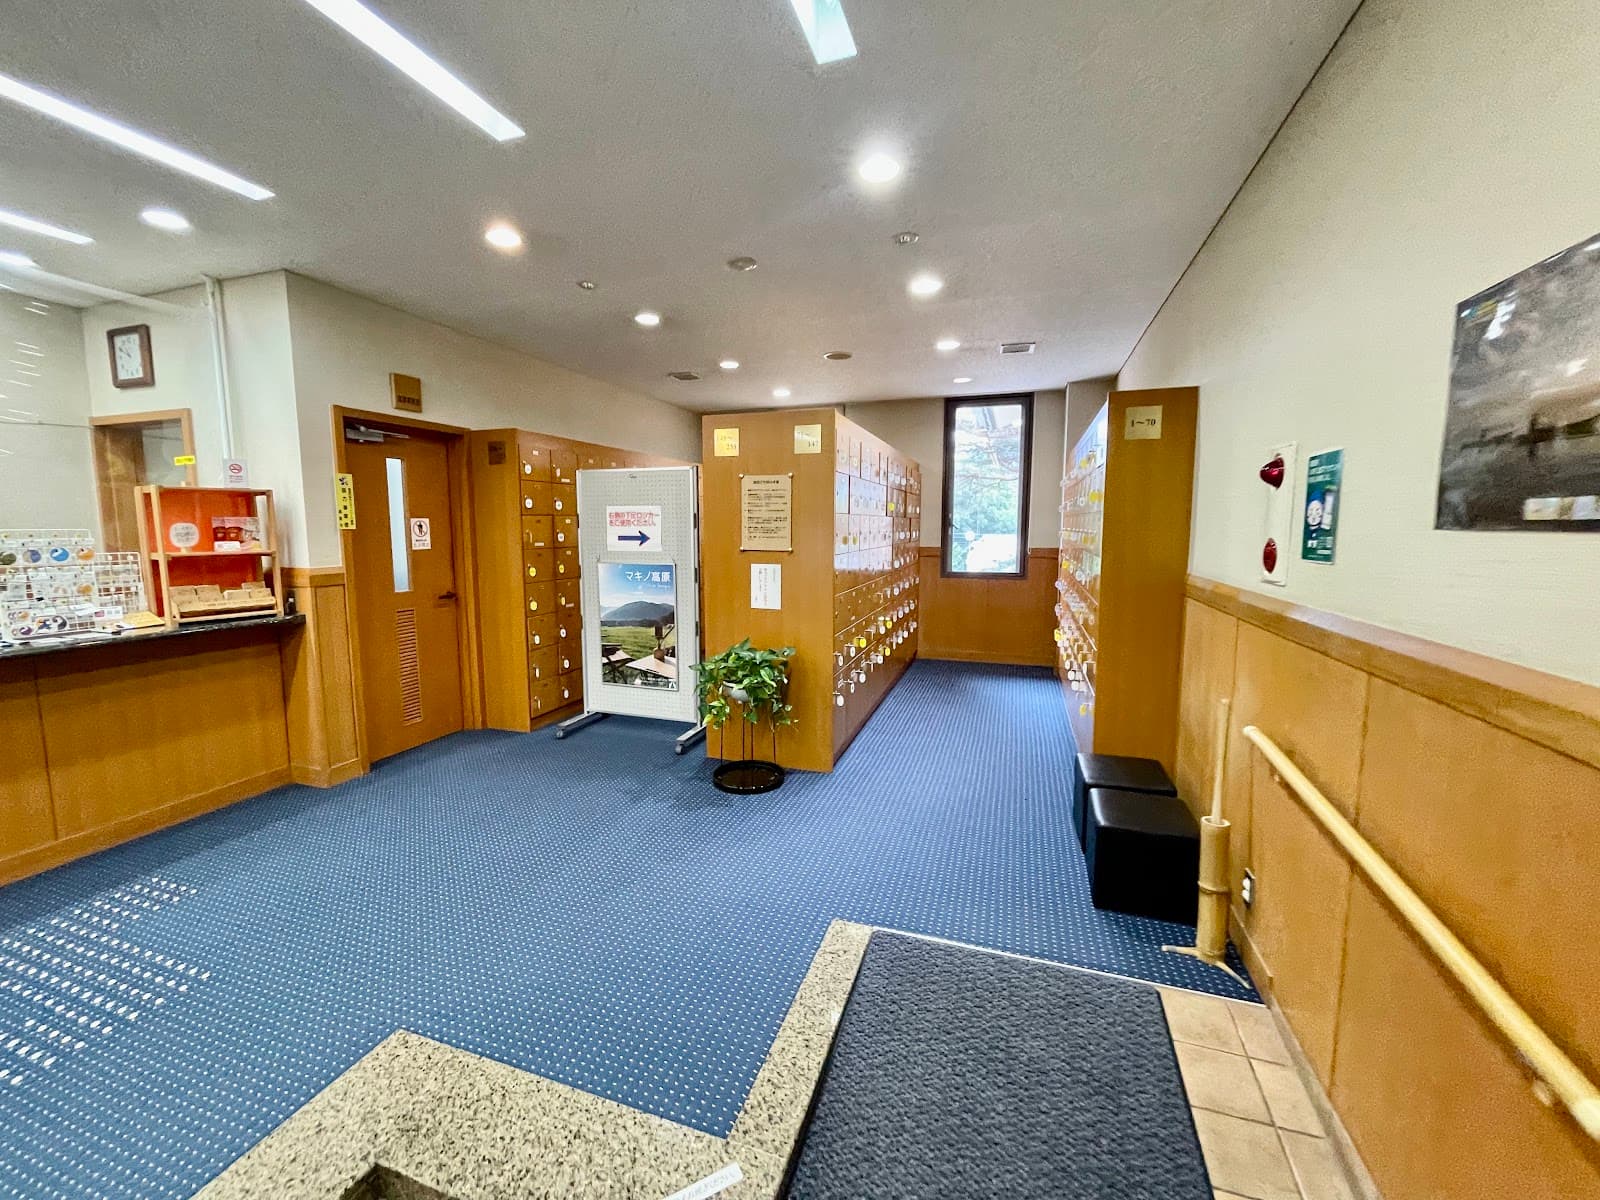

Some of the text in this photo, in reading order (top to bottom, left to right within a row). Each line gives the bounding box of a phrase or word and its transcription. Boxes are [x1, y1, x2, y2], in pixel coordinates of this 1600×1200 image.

[624, 570, 671, 583] マキノ高原
